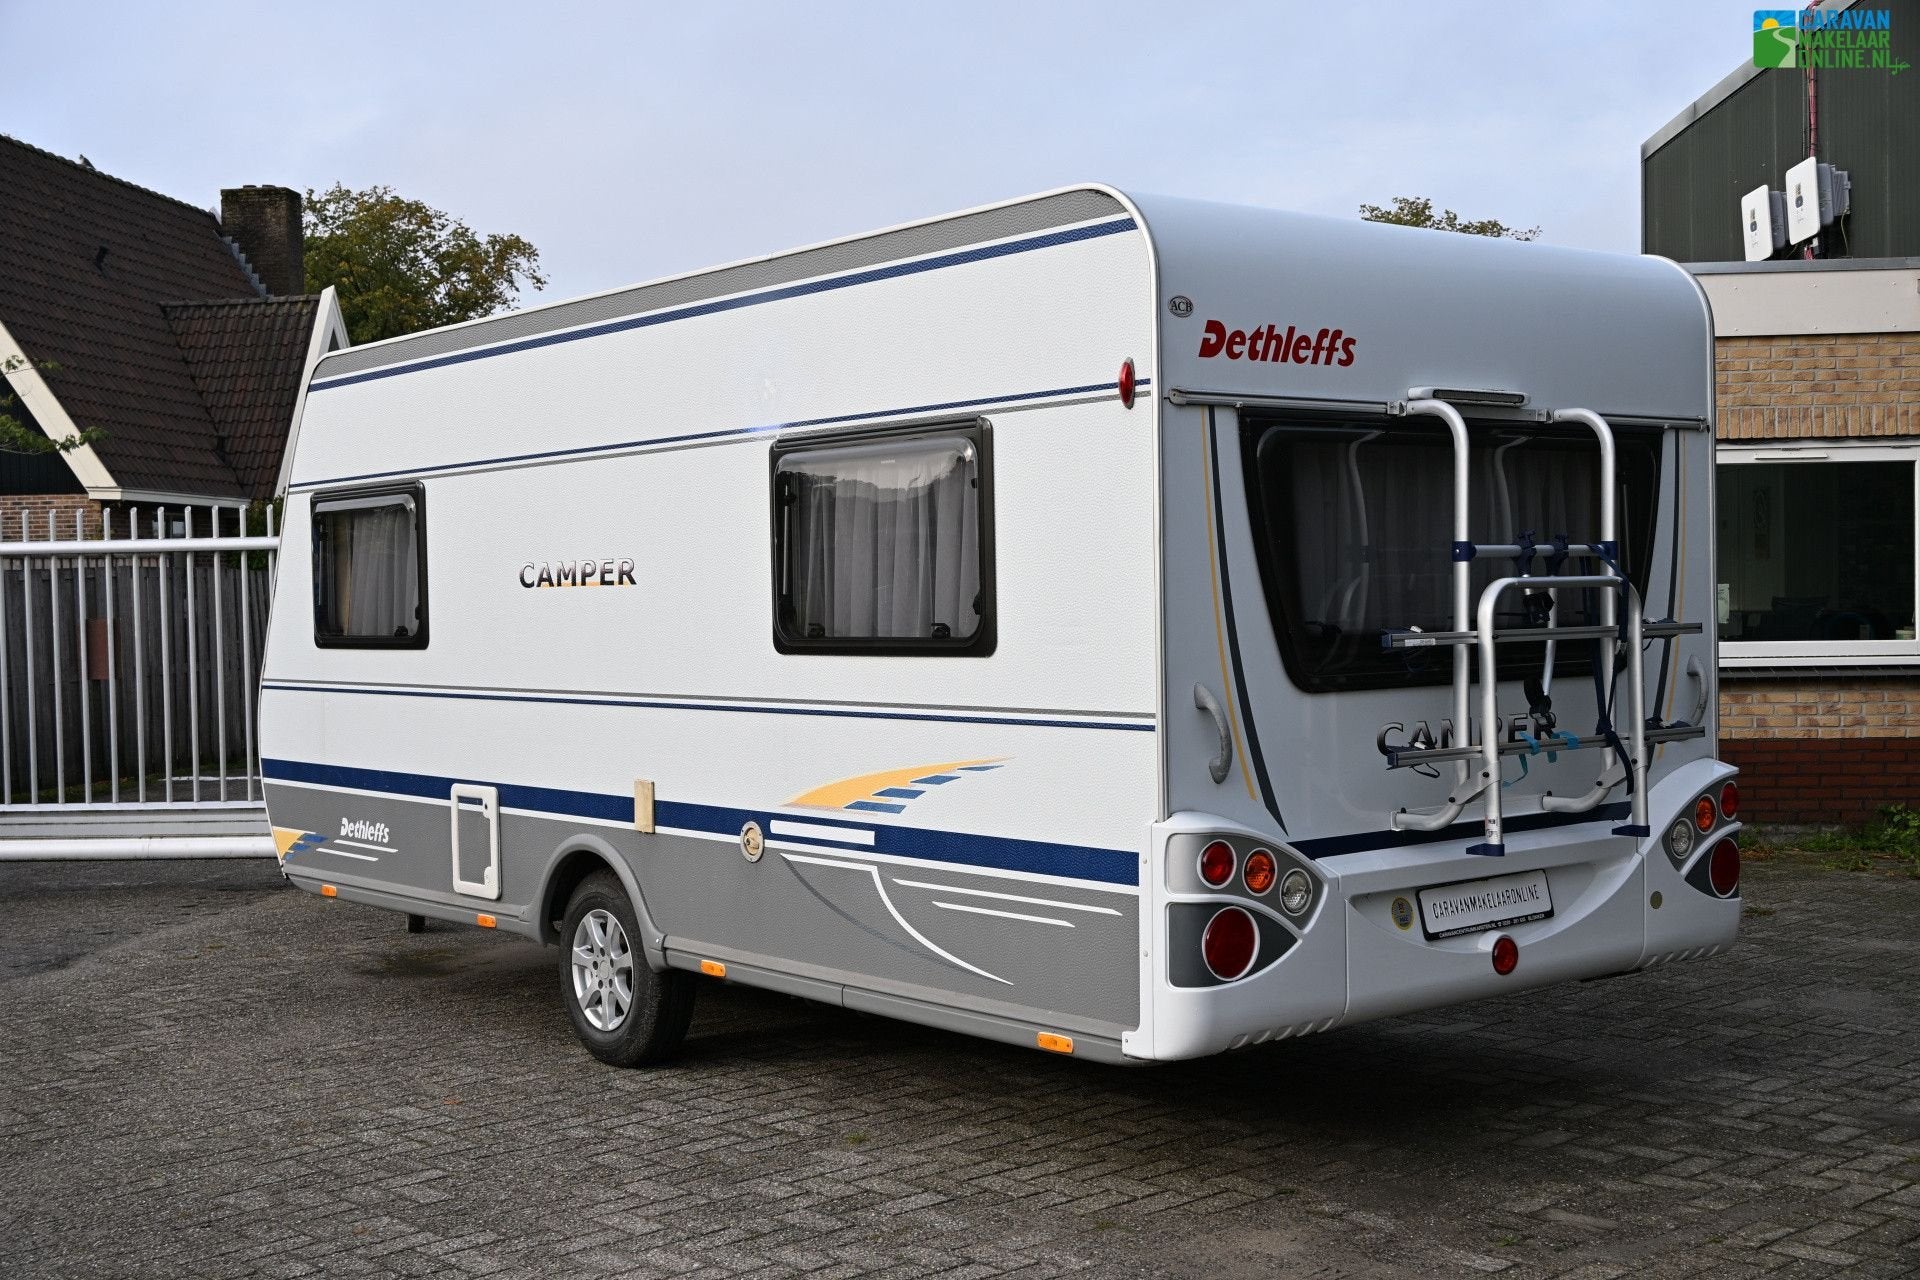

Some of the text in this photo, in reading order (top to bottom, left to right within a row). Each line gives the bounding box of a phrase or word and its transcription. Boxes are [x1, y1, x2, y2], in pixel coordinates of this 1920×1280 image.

[1198, 319, 1357, 367] Dethleffs
[519, 558, 637, 588] CAMPER
[1376, 711, 1557, 757] CAER
[340, 817, 390, 843] Dethleffs
[1432, 884, 1540, 919] CARAVANMAKELAARONLINE
